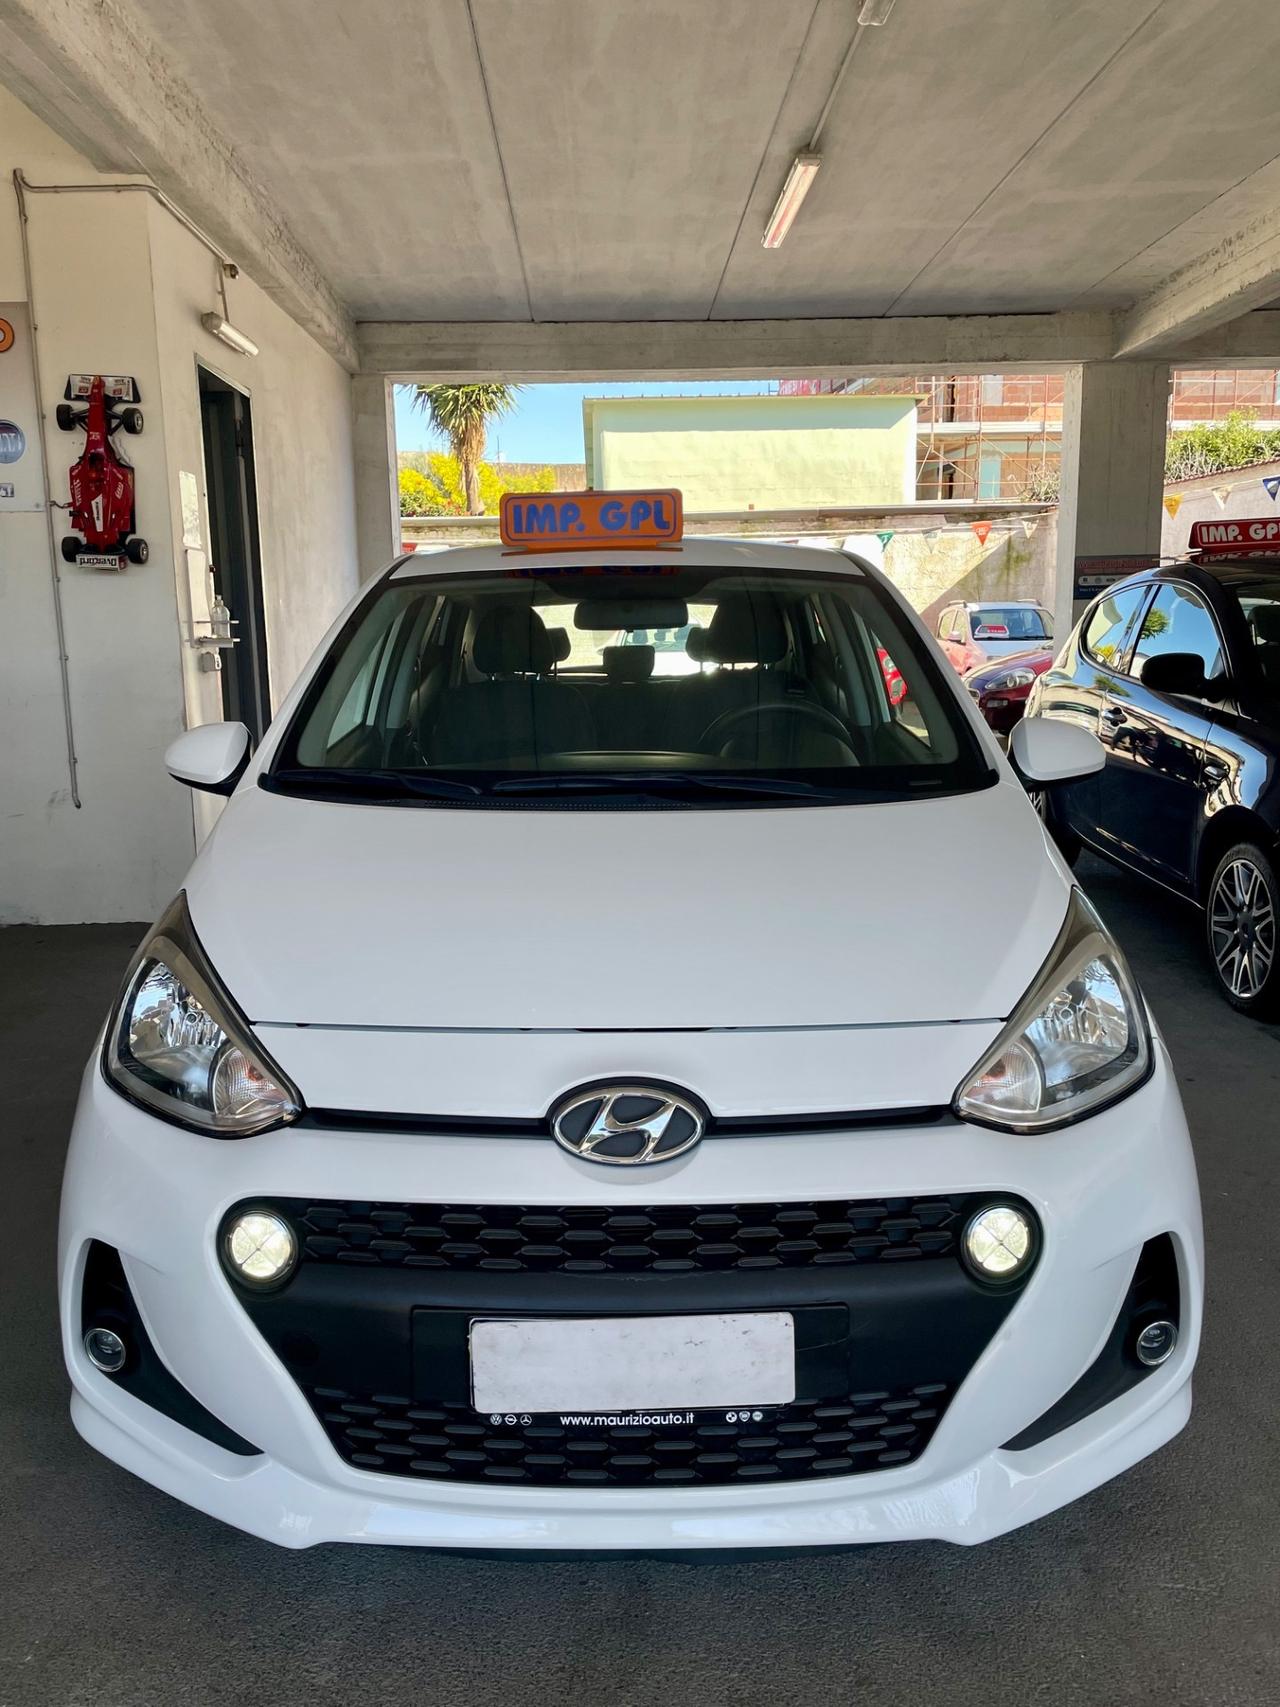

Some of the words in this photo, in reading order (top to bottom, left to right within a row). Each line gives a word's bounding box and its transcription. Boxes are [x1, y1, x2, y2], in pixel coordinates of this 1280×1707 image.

[513, 503, 584, 533] IMP.
[599, 501, 669, 530] GPL
[1202, 526, 1243, 542] IMP.
[1249, 524, 1280, 540] GP
[560, 1413, 695, 1427] www.maurizioauto.it
